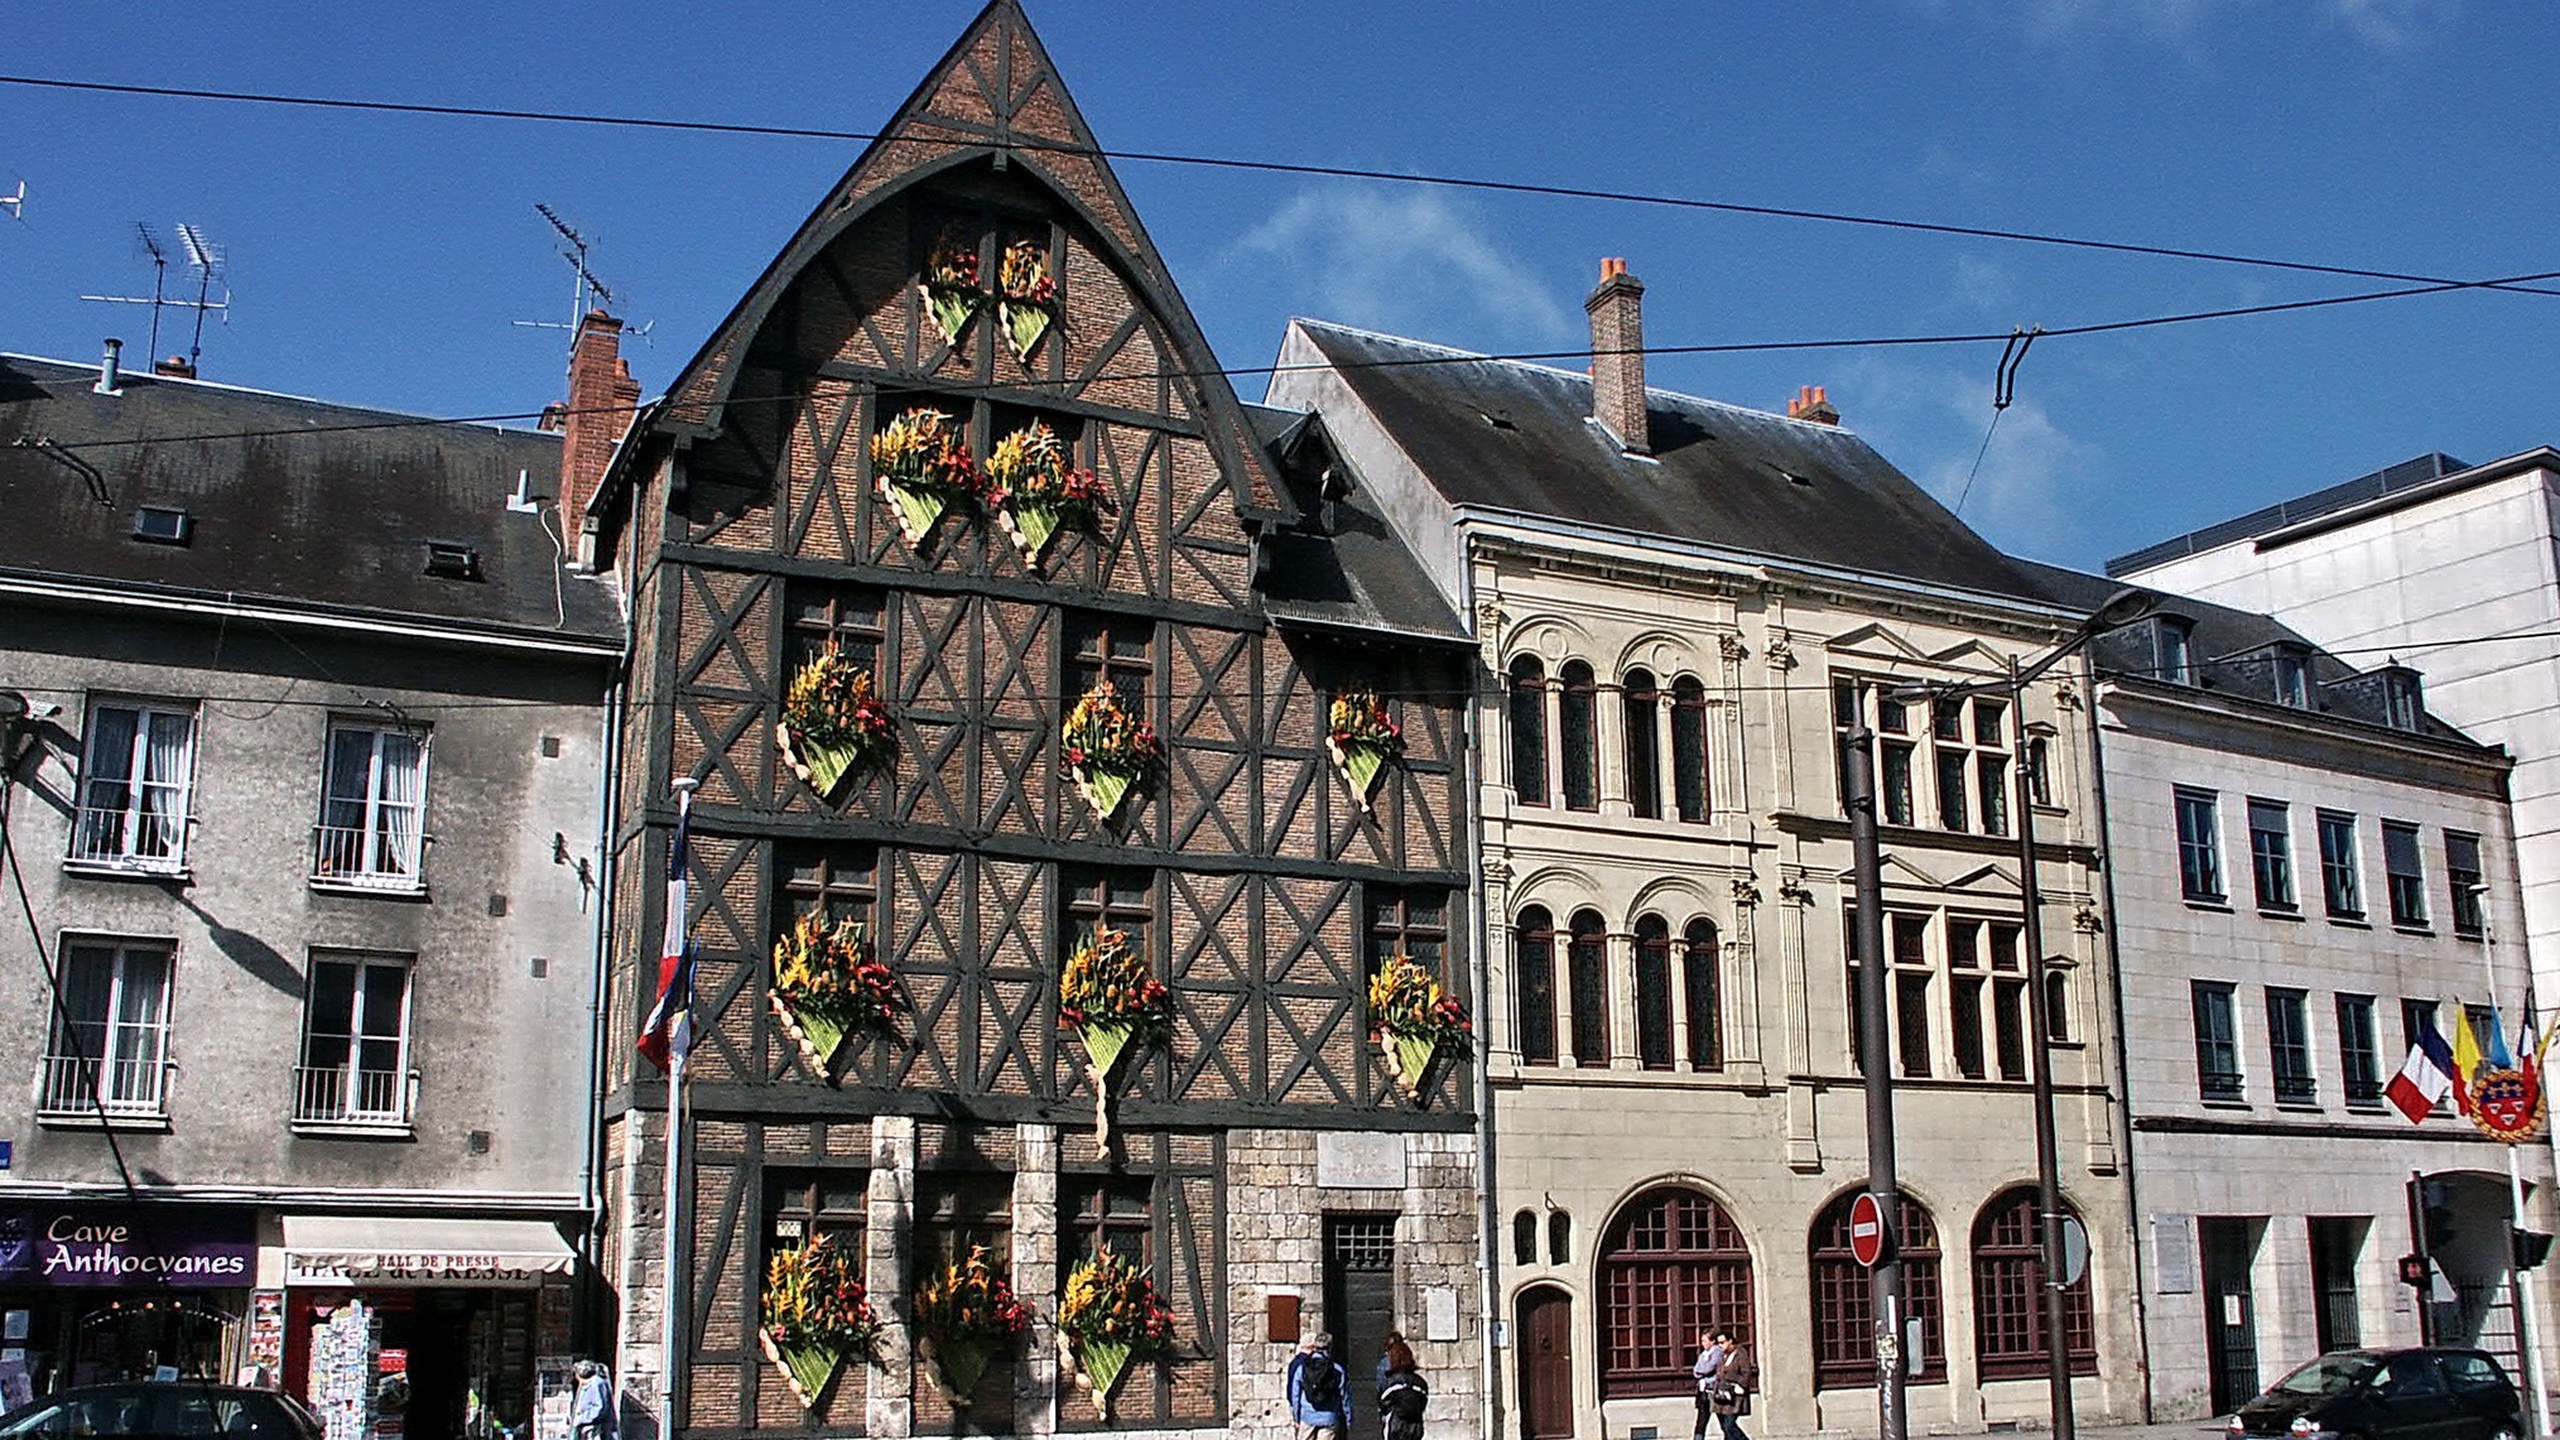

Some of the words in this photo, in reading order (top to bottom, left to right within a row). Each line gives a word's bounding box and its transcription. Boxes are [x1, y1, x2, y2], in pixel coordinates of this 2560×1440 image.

[47, 1215, 129, 1242] Cave
[377, 1255, 413, 1267] HALL
[420, 1256, 438, 1268] DE
[446, 1256, 500, 1268] PRESSE
